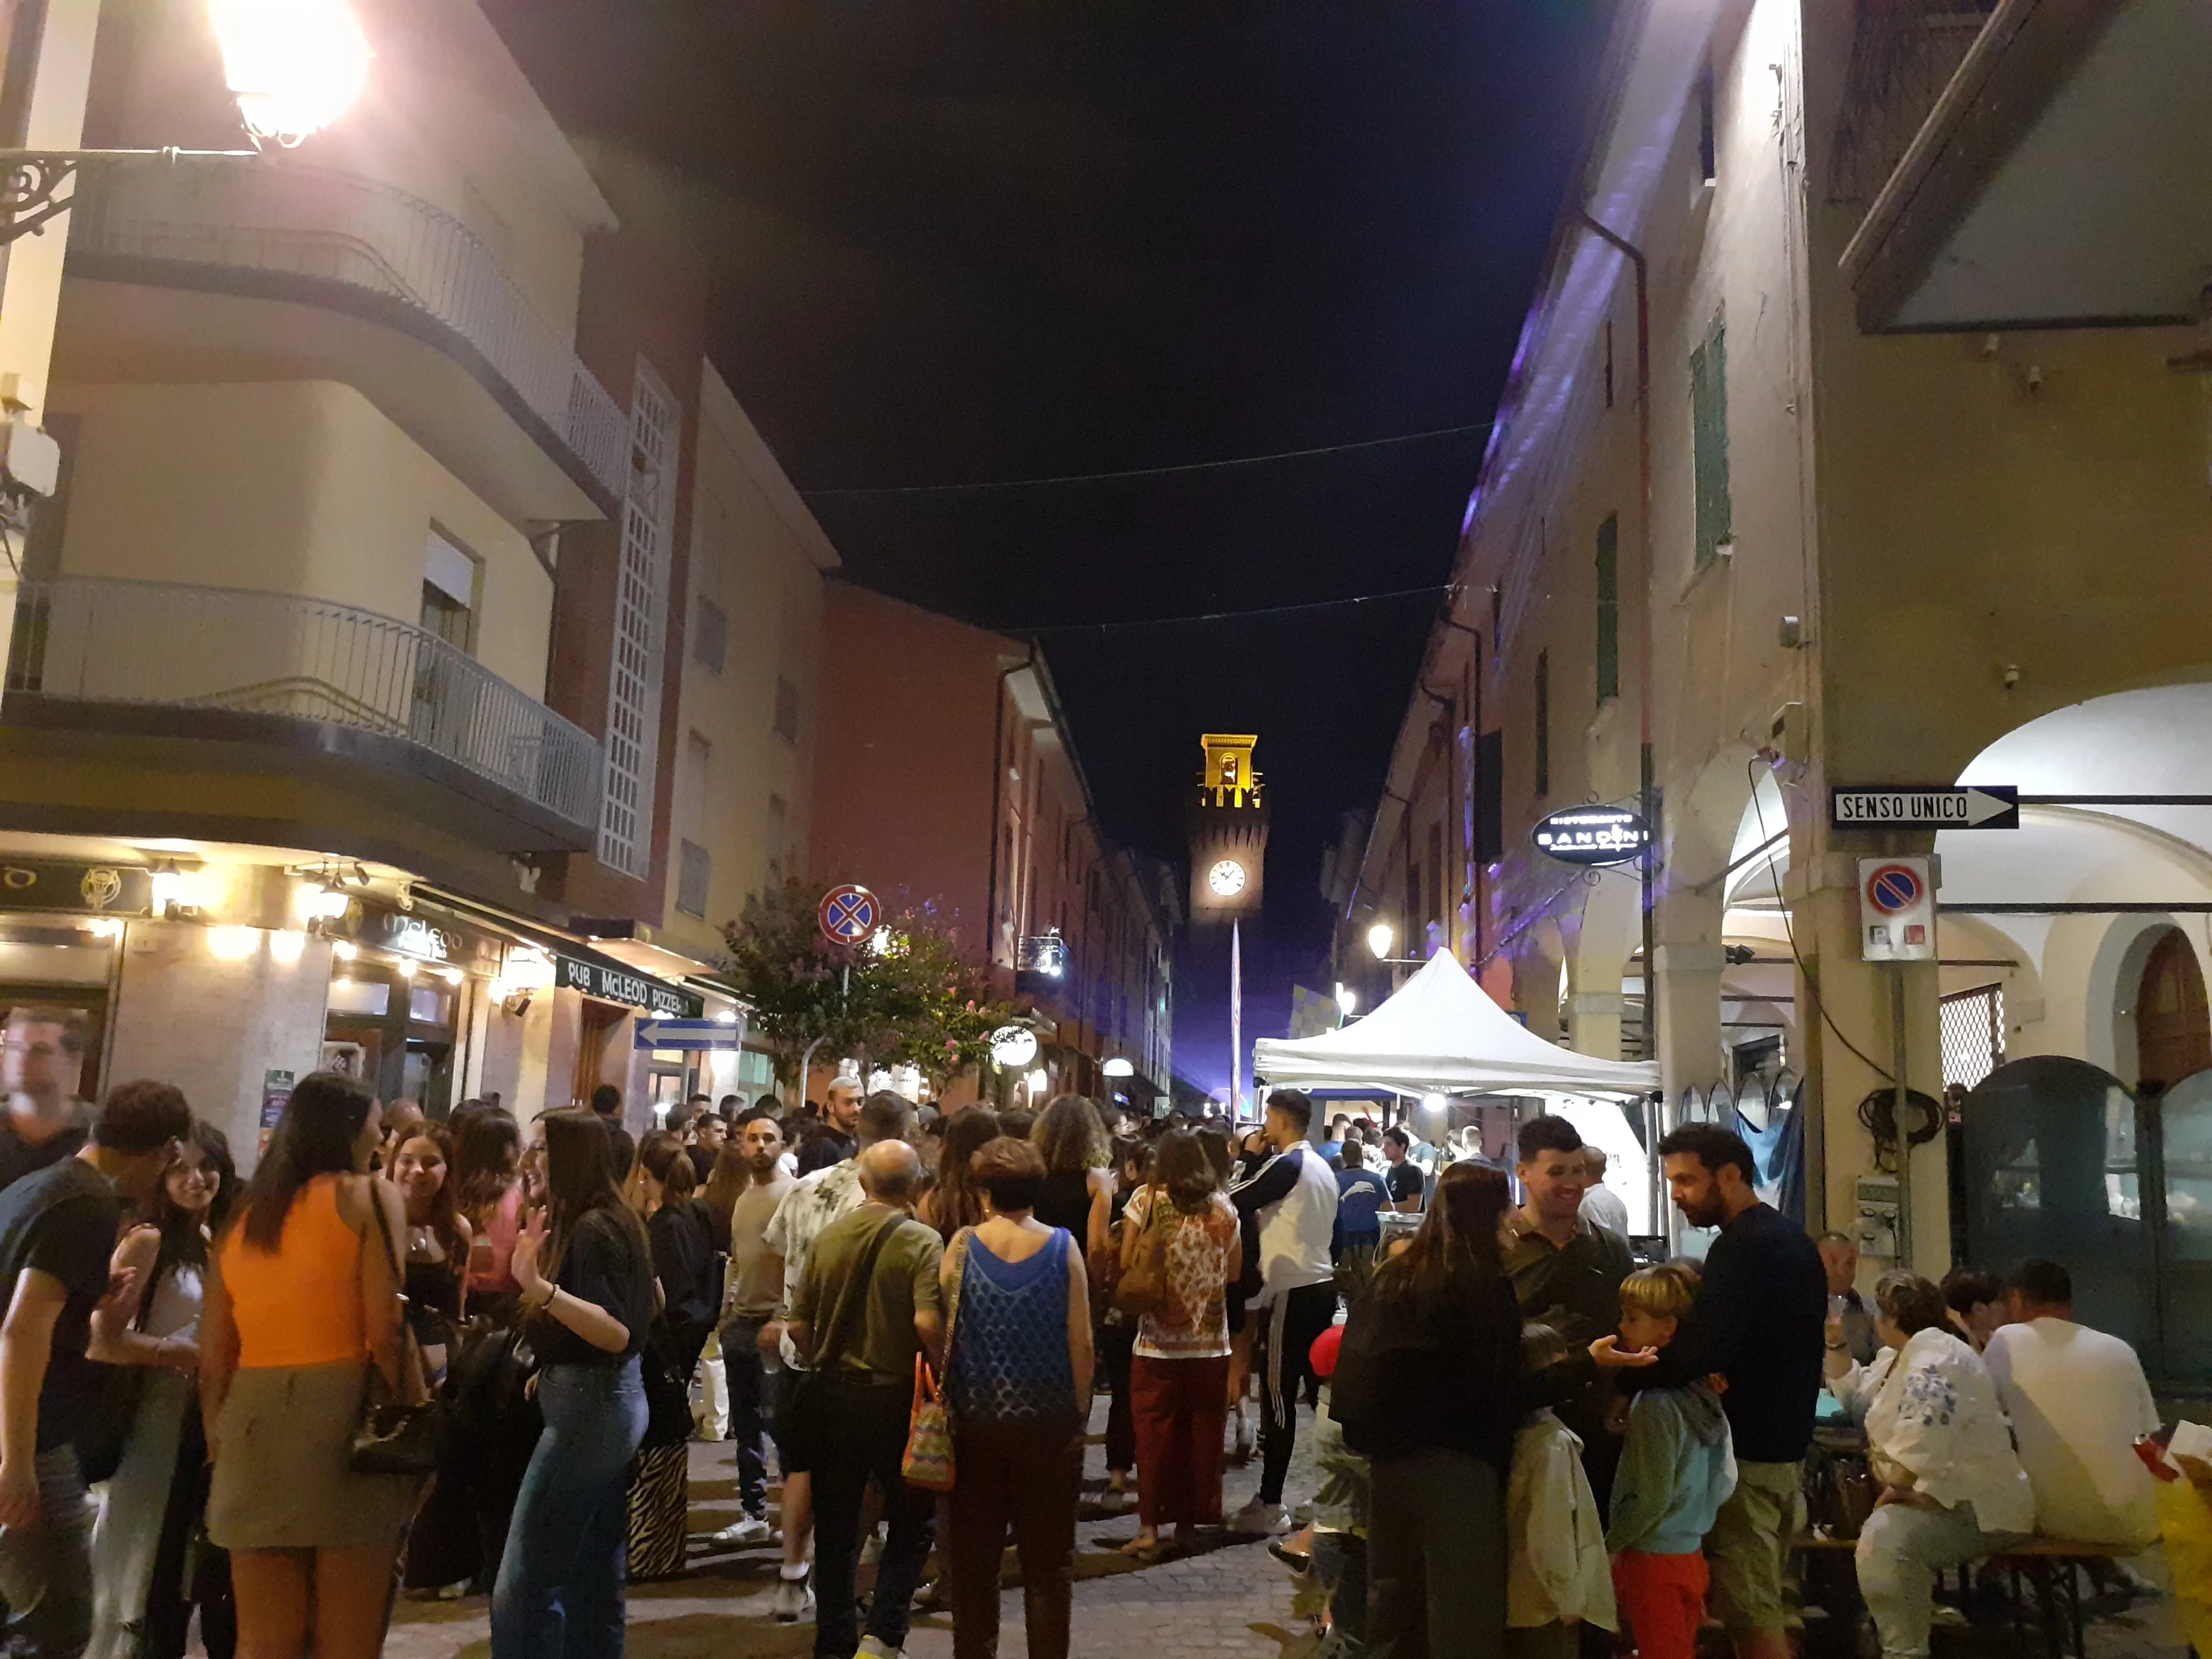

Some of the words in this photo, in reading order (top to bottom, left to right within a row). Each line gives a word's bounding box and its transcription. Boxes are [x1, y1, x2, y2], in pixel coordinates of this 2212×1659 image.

[1842, 796, 1903, 818] SENSO
[1911, 796, 1968, 818] UNICO
[568, 962, 591, 987] PUB
[602, 970, 647, 1004] McLEOD
[652, 989, 689, 1013] PIZZERA
